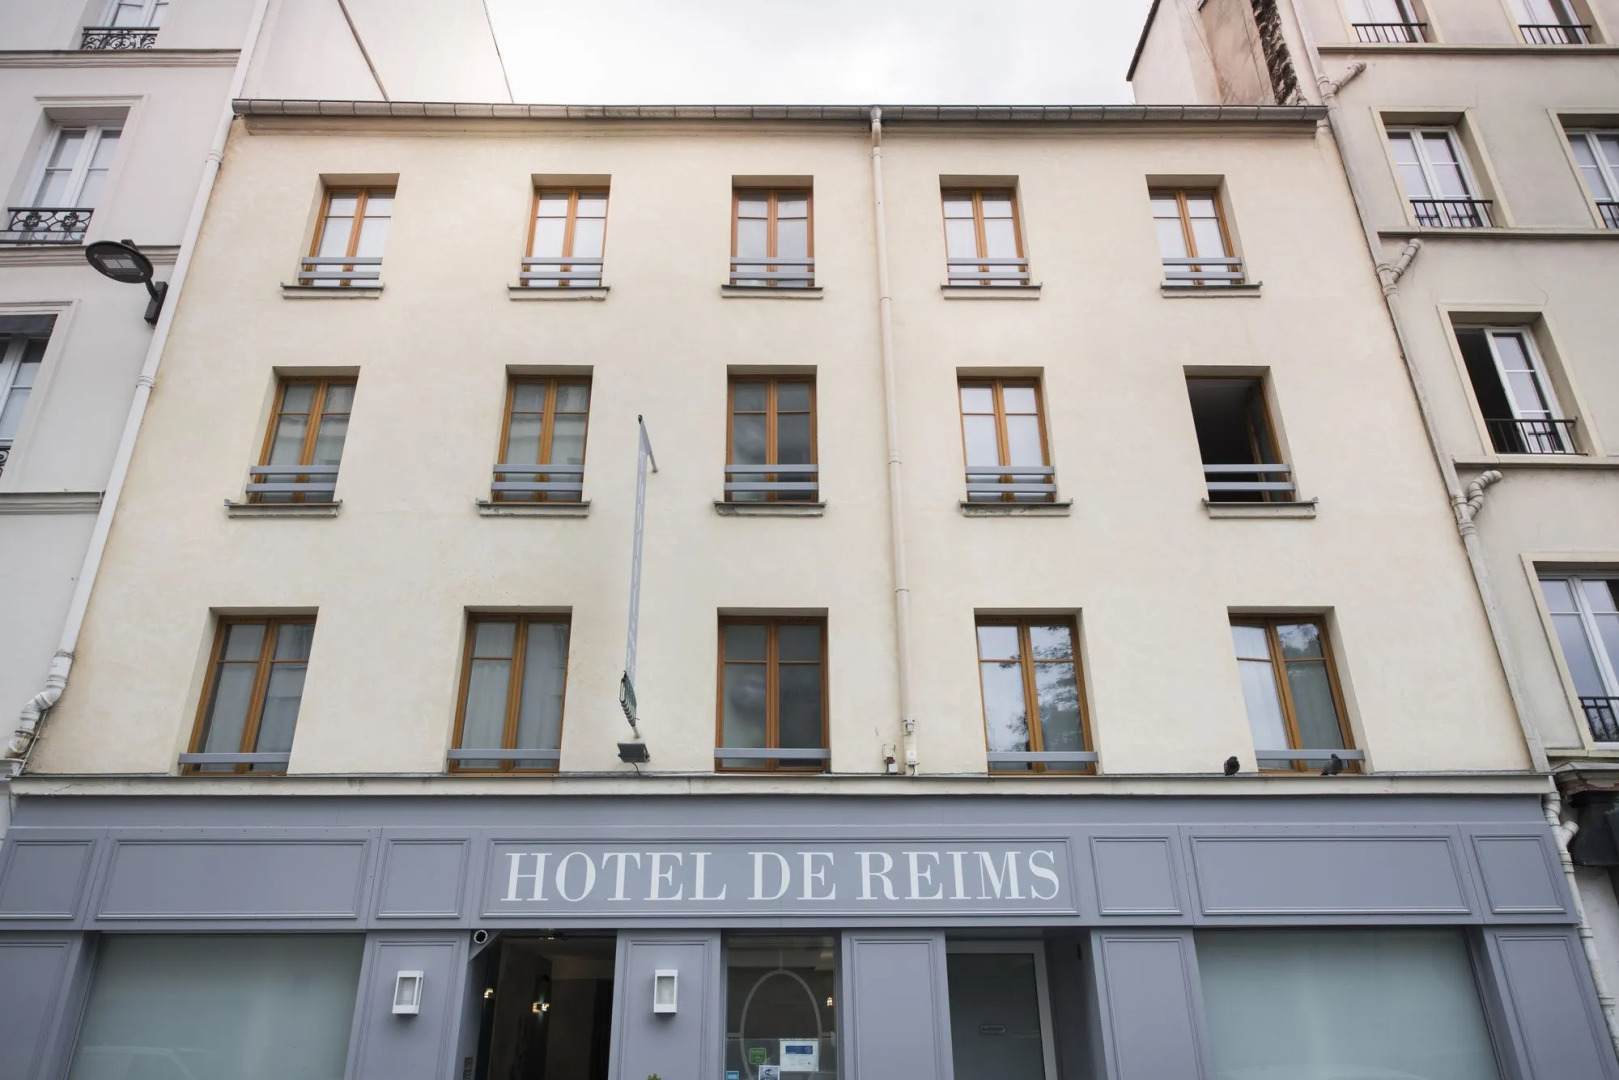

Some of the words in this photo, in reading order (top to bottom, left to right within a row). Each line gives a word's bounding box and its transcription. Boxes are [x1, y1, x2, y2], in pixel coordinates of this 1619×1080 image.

[501, 852, 727, 902] HOTEL
[747, 852, 836, 901] DE
[854, 851, 1059, 901] REIMS
